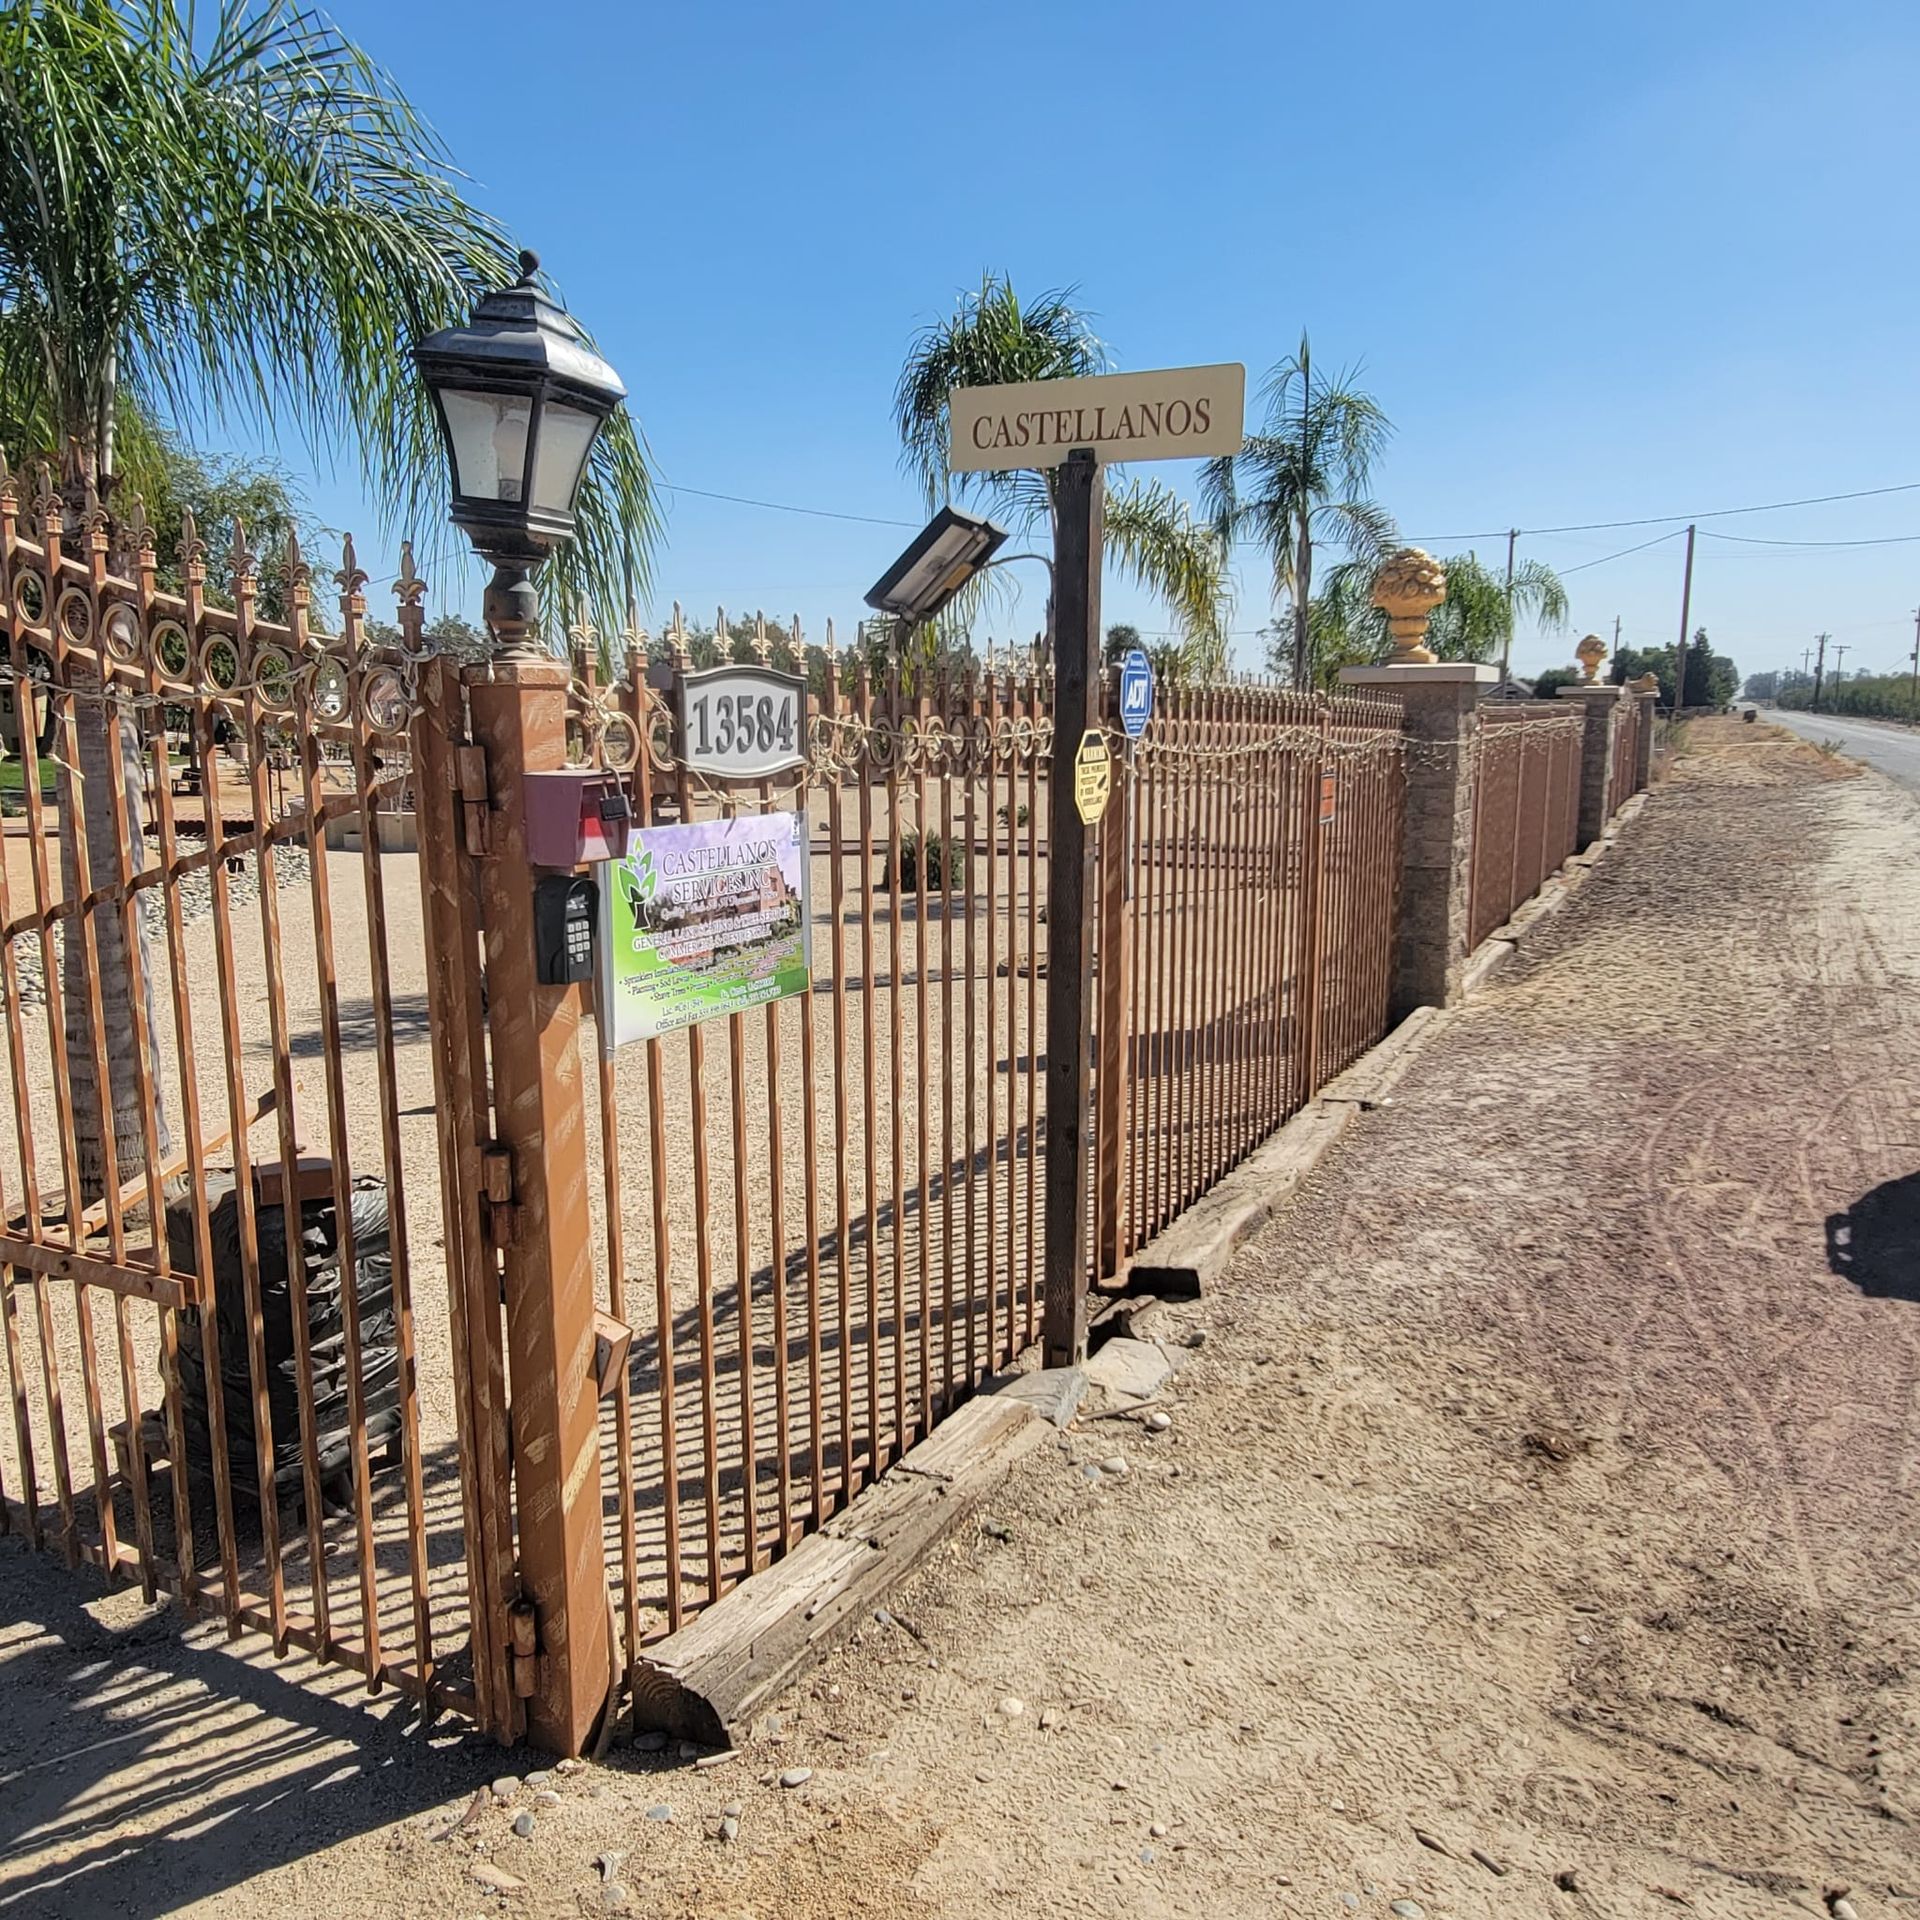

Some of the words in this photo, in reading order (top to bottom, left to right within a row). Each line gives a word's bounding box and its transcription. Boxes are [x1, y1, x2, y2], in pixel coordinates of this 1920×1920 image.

[972, 398, 1210, 450] CASTELLANOS
[1125, 680, 1148, 710] ADT
[692, 694, 794, 755] 13584
[662, 838, 777, 876] CASTELLANOS
